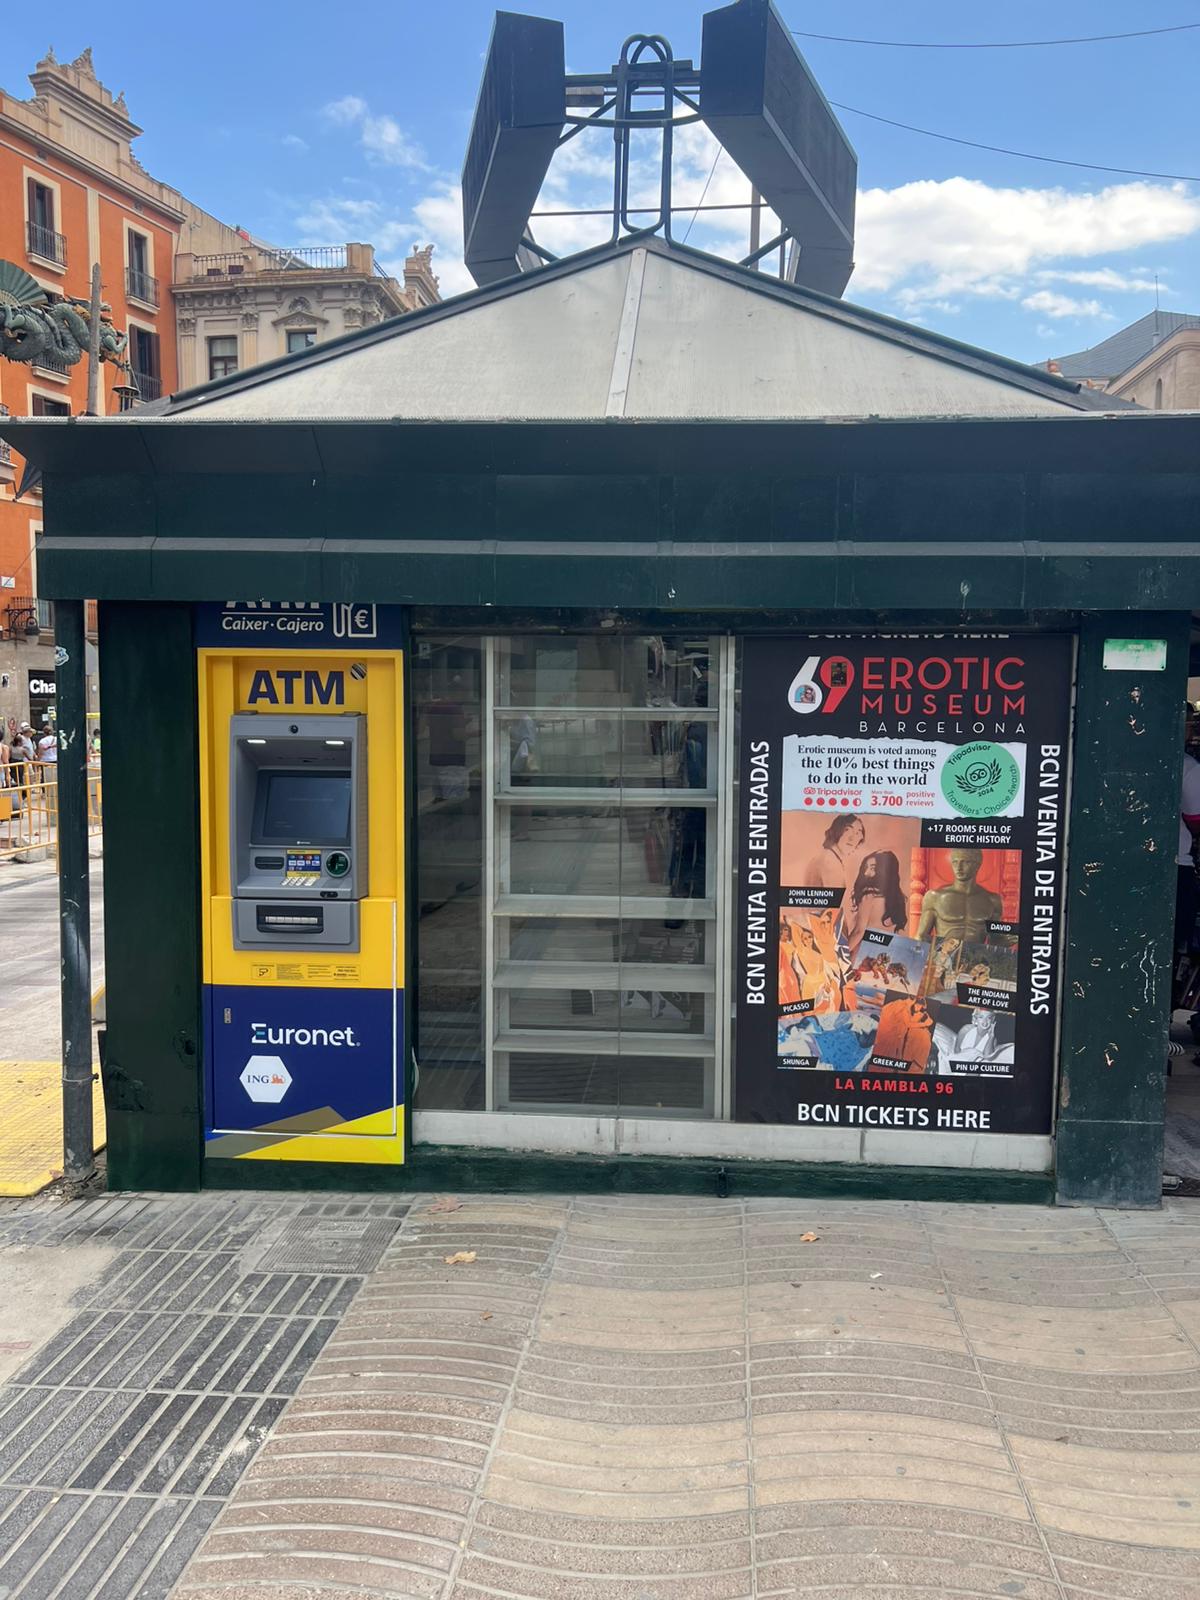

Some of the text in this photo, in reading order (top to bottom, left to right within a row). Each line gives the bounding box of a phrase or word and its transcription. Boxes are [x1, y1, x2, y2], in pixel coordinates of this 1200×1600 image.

[862, 656, 1025, 691] EROTIC
[247, 669, 345, 705] ATM
[787, 655, 855, 714] 69
[860, 693, 1026, 716] MUSEUM
[859, 720, 1026, 734] BARCELONA
[798, 745, 937, 757] Erotic museum is voted among
[947, 744, 992, 766] Tripadvisor
[801, 756, 935, 773] the 10% best things
[808, 772, 927, 786] to do in the world
[817, 788, 862, 796] Tripadvisor
[906, 791, 936, 799] positive
[983, 796, 1011, 815] Choice
[1007, 764, 1019, 796] Awards
[871, 796, 903, 806] 3.700
[946, 825, 976, 833] ROOMS
[979, 825, 998, 834] FULL
[945, 835, 1011, 844] EROTIC HISTORY
[747, 740, 770, 1004] BCN VENTA DE ENTRADAS
[1029, 744, 1061, 1015] BCN VENTA DE ENTRADAS
[814, 898, 828, 906] ONO
[991, 923, 1012, 932] DAVID
[968, 988, 1010, 1000] THE INDIANA
[783, 1002, 810, 1013] PICASSO
[992, 1000, 1008, 1008] LOVE
[252, 1023, 356, 1047] Euronet
[782, 1058, 810, 1066] SHUNGA
[873, 1058, 908, 1068] GREEK ART
[956, 1064, 967, 1072] PIN
[248, 1075, 269, 1084] ING
[835, 1078, 954, 1094] LA RAMBLA 96
[798, 1103, 991, 1128] BCN TICKETS HERE
